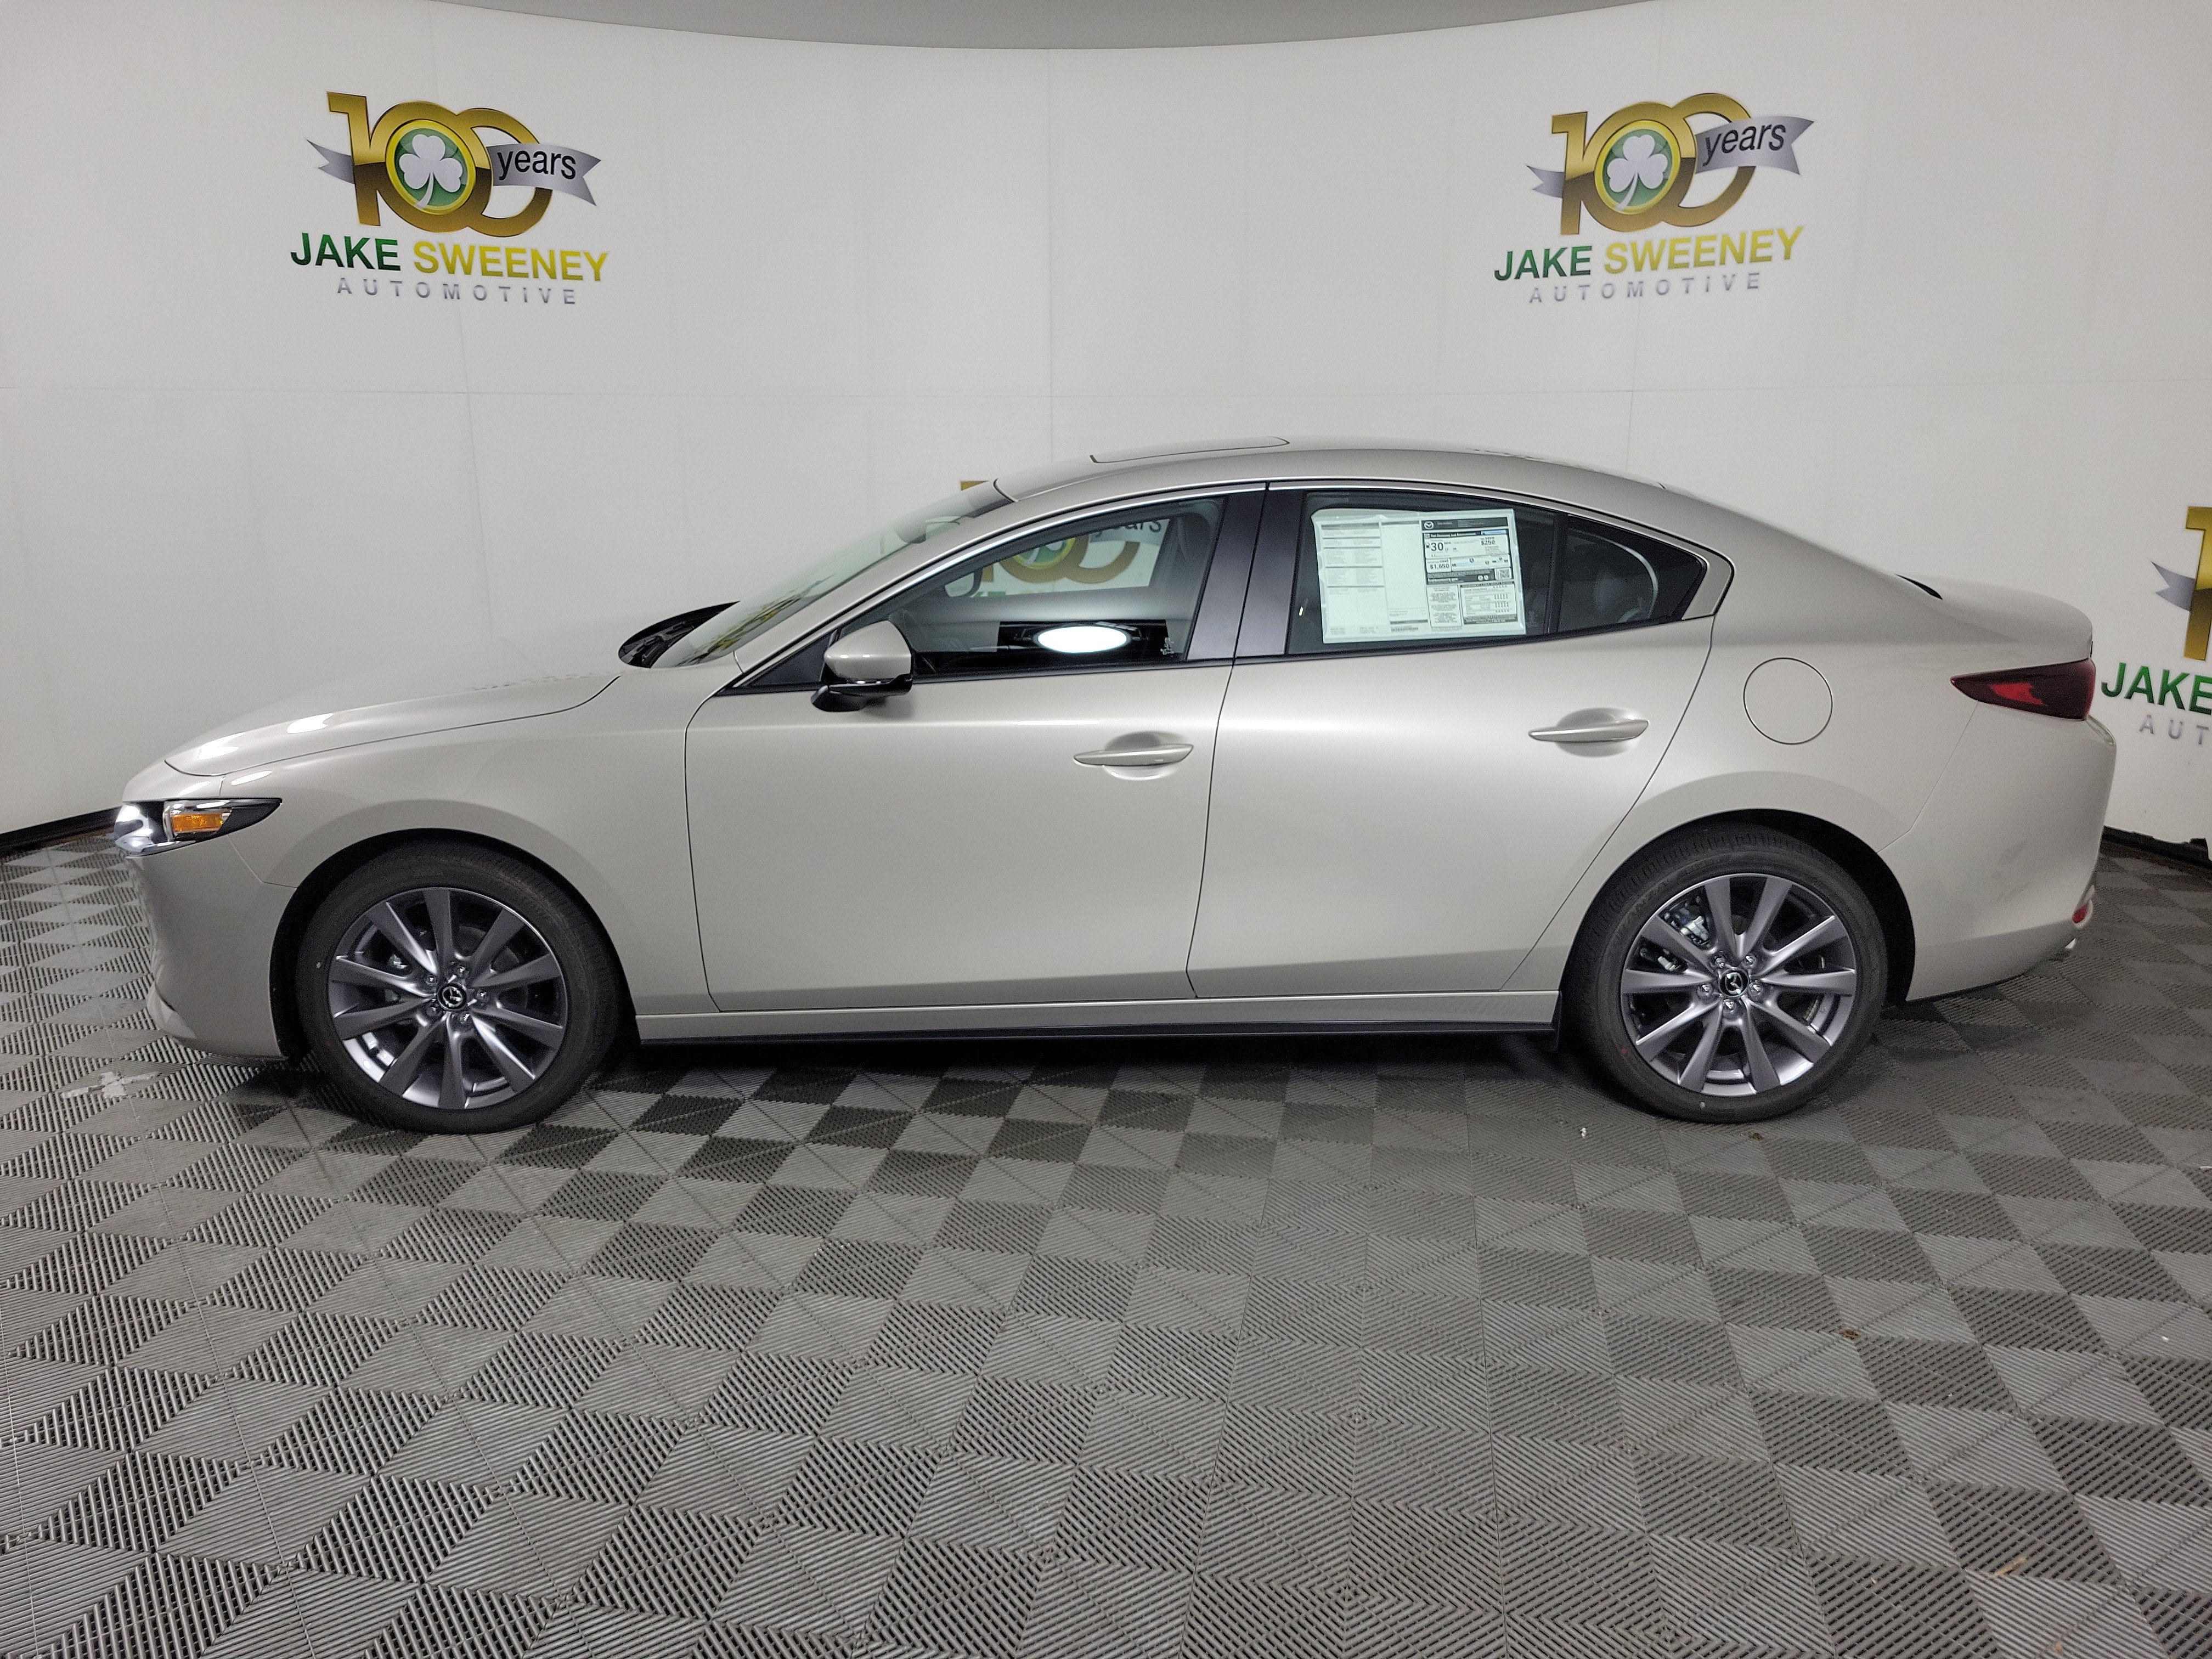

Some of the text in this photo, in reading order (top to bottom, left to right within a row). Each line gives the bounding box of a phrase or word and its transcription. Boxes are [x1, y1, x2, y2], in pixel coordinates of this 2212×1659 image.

[326, 91, 552, 237] 100
[497, 149, 577, 180] years
[1551, 93, 1756, 235] 100
[1702, 123, 1786, 167] years
[290, 232, 609, 281] JAKE SWEENEY
[1494, 226, 1803, 281] JAKE SWEENEY
[337, 277, 575, 305] AUTOMOTIVE
[1529, 272, 1760, 303] AUTOMOTIVE
[1431, 542, 1443, 551] 30
[2101, 662, 2212, 715] JAKE
